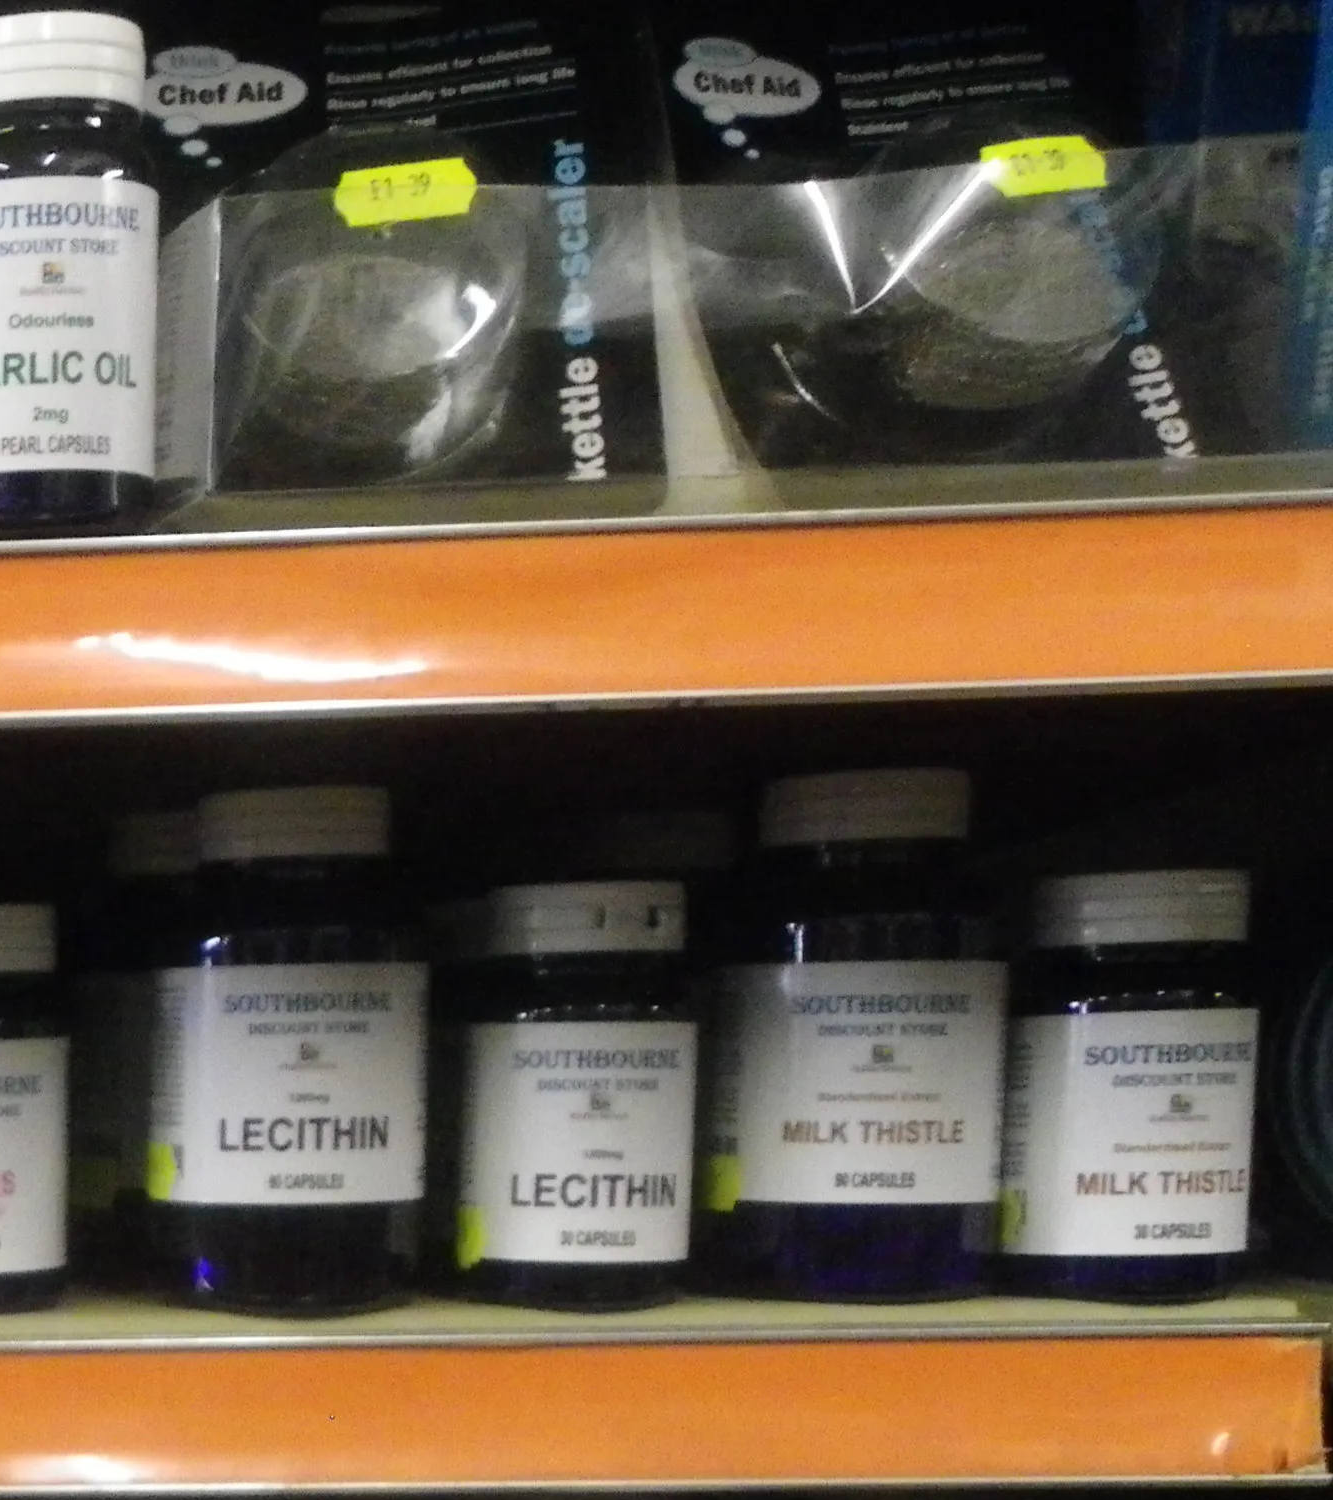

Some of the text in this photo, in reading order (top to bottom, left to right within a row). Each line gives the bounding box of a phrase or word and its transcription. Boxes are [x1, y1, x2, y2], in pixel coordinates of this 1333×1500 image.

[158, 81, 284, 106] Chef Aid
[694, 71, 801, 97] Chef Aid
[7, 311, 94, 331] Odourless
[95, 352, 136, 388] OIL
[33, 405, 68, 423] 2mg
[558, 356, 607, 482] kettle
[2, 436, 44, 456] PEARL
[219, 1116, 390, 1153] LECITHIN
[783, 1120, 965, 1144] MILK THISTLE
[511, 1173, 676, 1208] LECITHIN
[1076, 1168, 1246, 1196] MILK THISTLE
